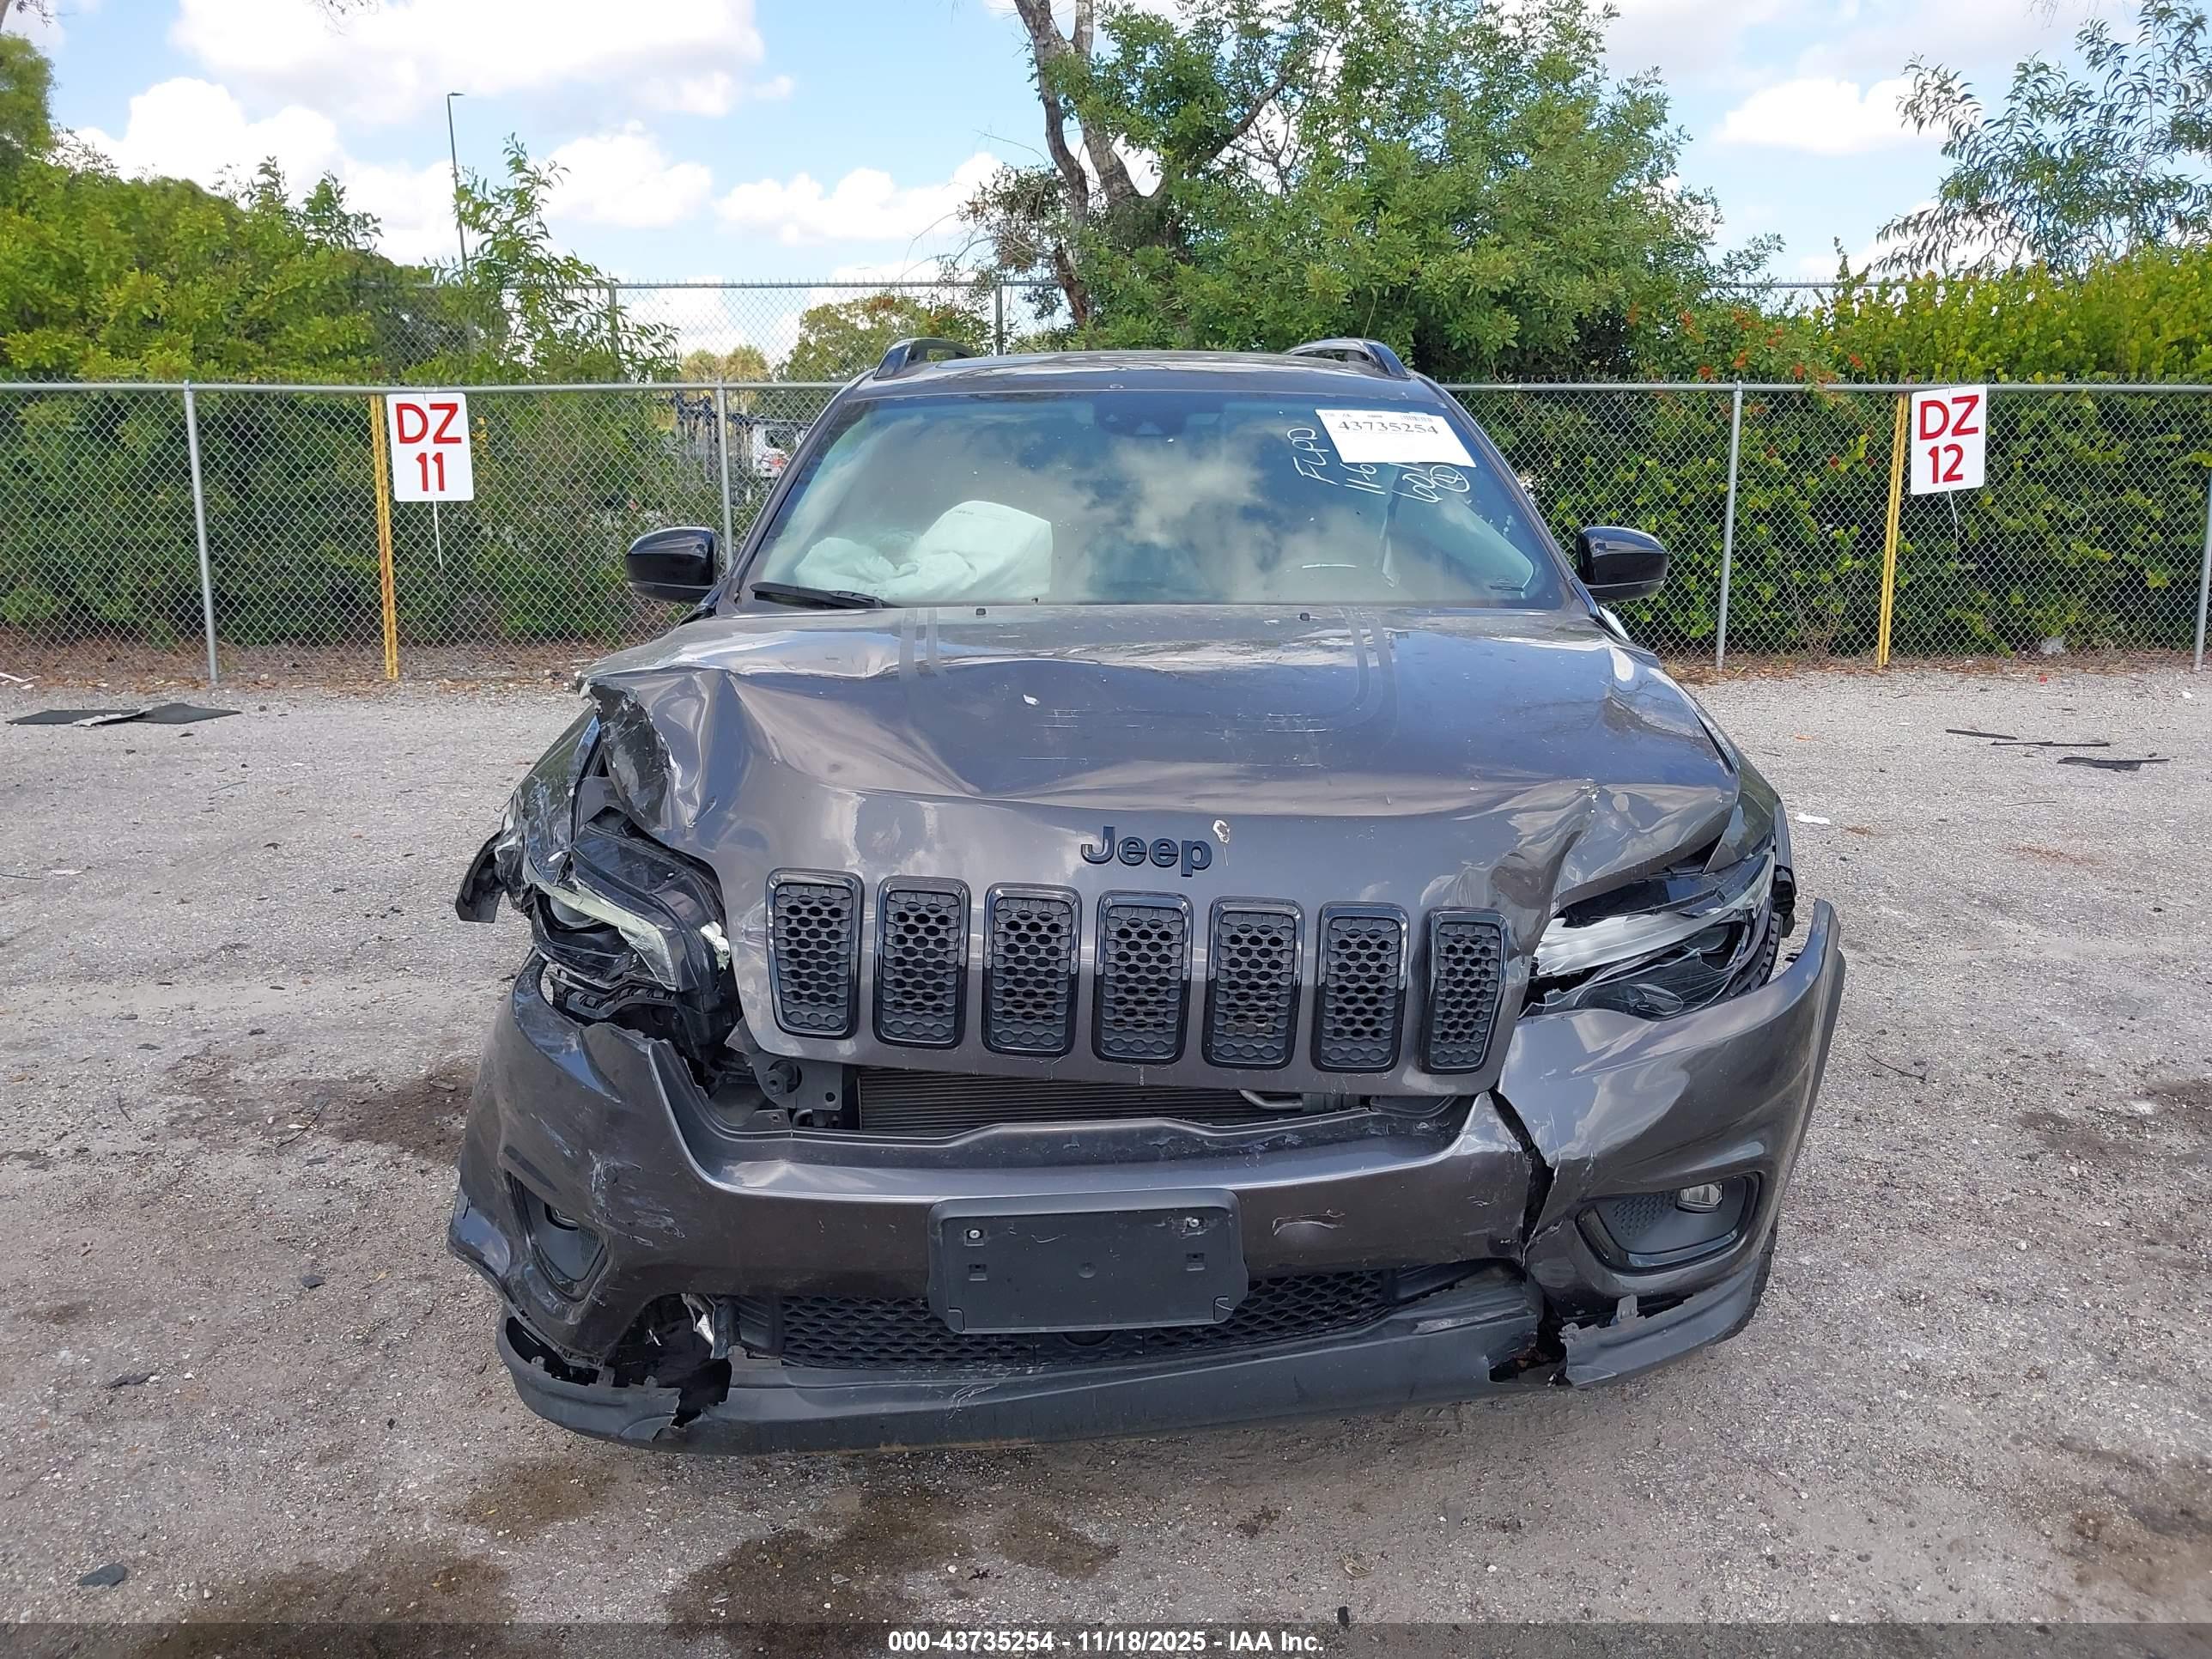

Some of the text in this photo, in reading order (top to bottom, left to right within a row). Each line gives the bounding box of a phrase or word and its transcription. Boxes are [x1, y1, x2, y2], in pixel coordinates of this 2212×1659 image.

[395, 403, 462, 444] DZ
[1338, 421, 1439, 434] 43735254
[1919, 394, 1979, 441] DZ
[416, 452, 446, 491] 11
[1927, 443, 1964, 483] 12
[1080, 825, 1212, 878] Jeep
